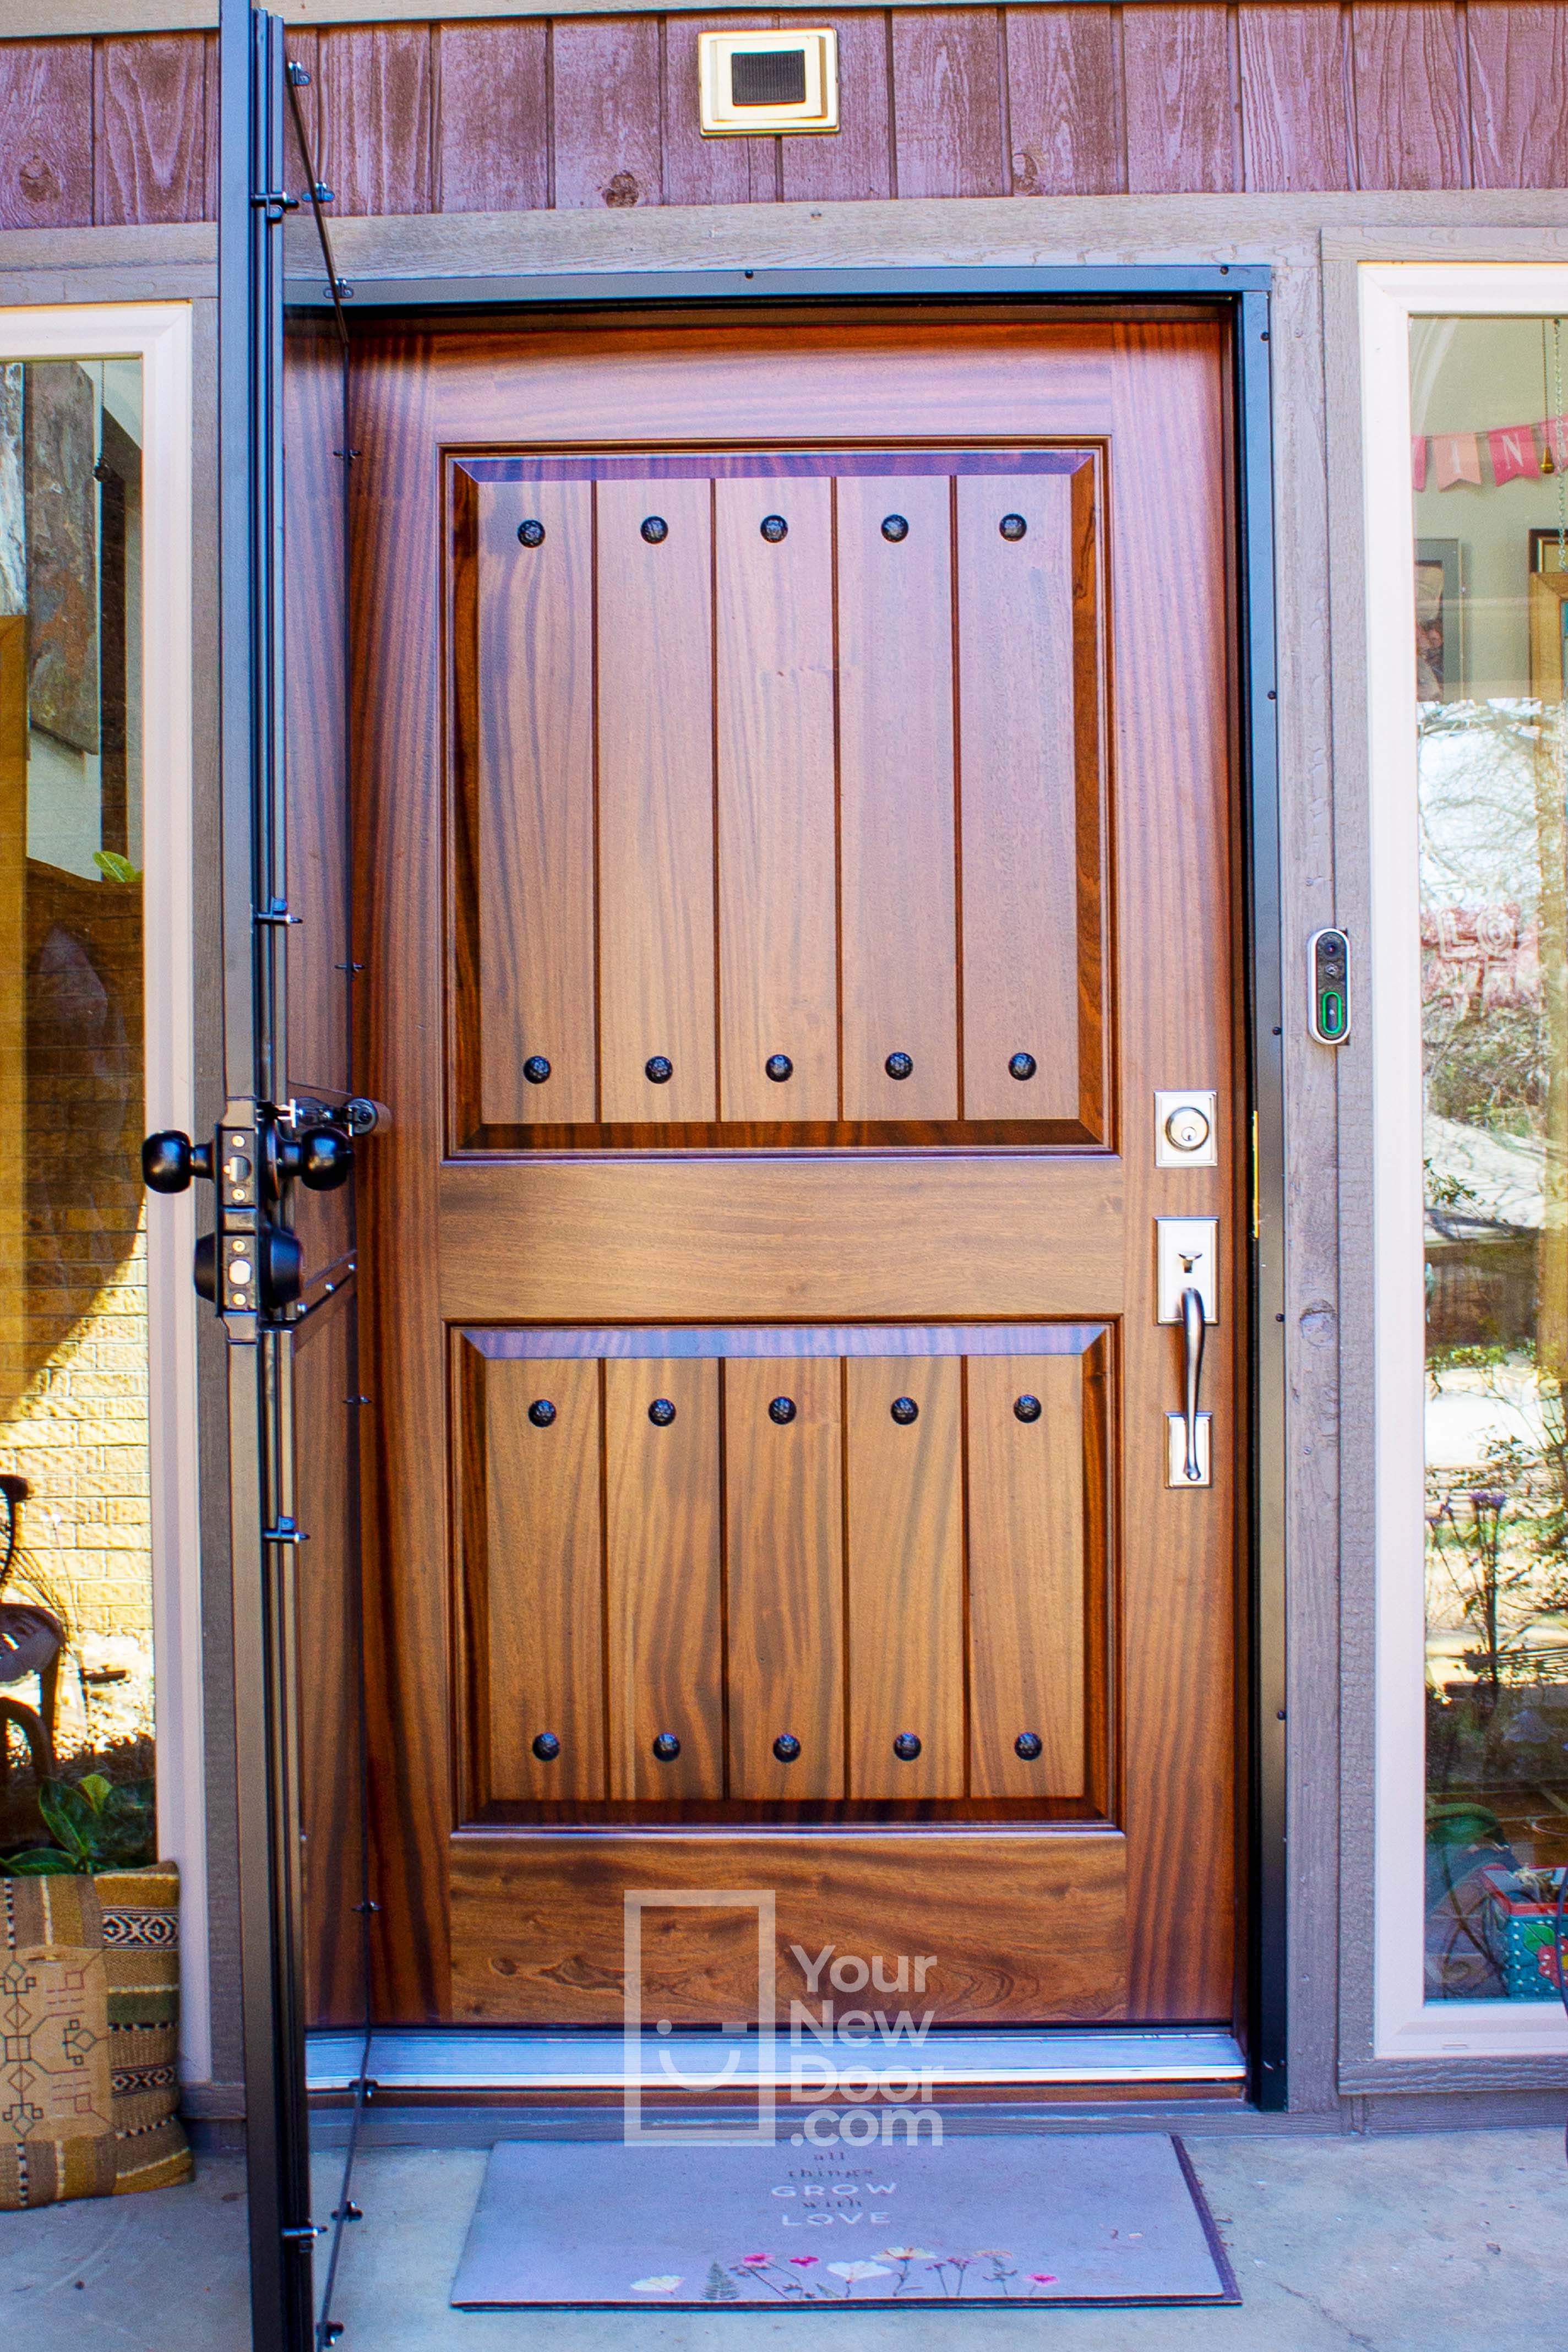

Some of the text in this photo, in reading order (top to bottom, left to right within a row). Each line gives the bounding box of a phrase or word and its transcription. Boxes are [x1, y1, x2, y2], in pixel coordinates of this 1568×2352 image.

[814, 2152, 845, 2160] all
[788, 2168, 873, 2178] things
[771, 2183, 896, 2197] GROW
[803, 2195, 863, 2208] with
[782, 2212, 891, 2226] LOVE
